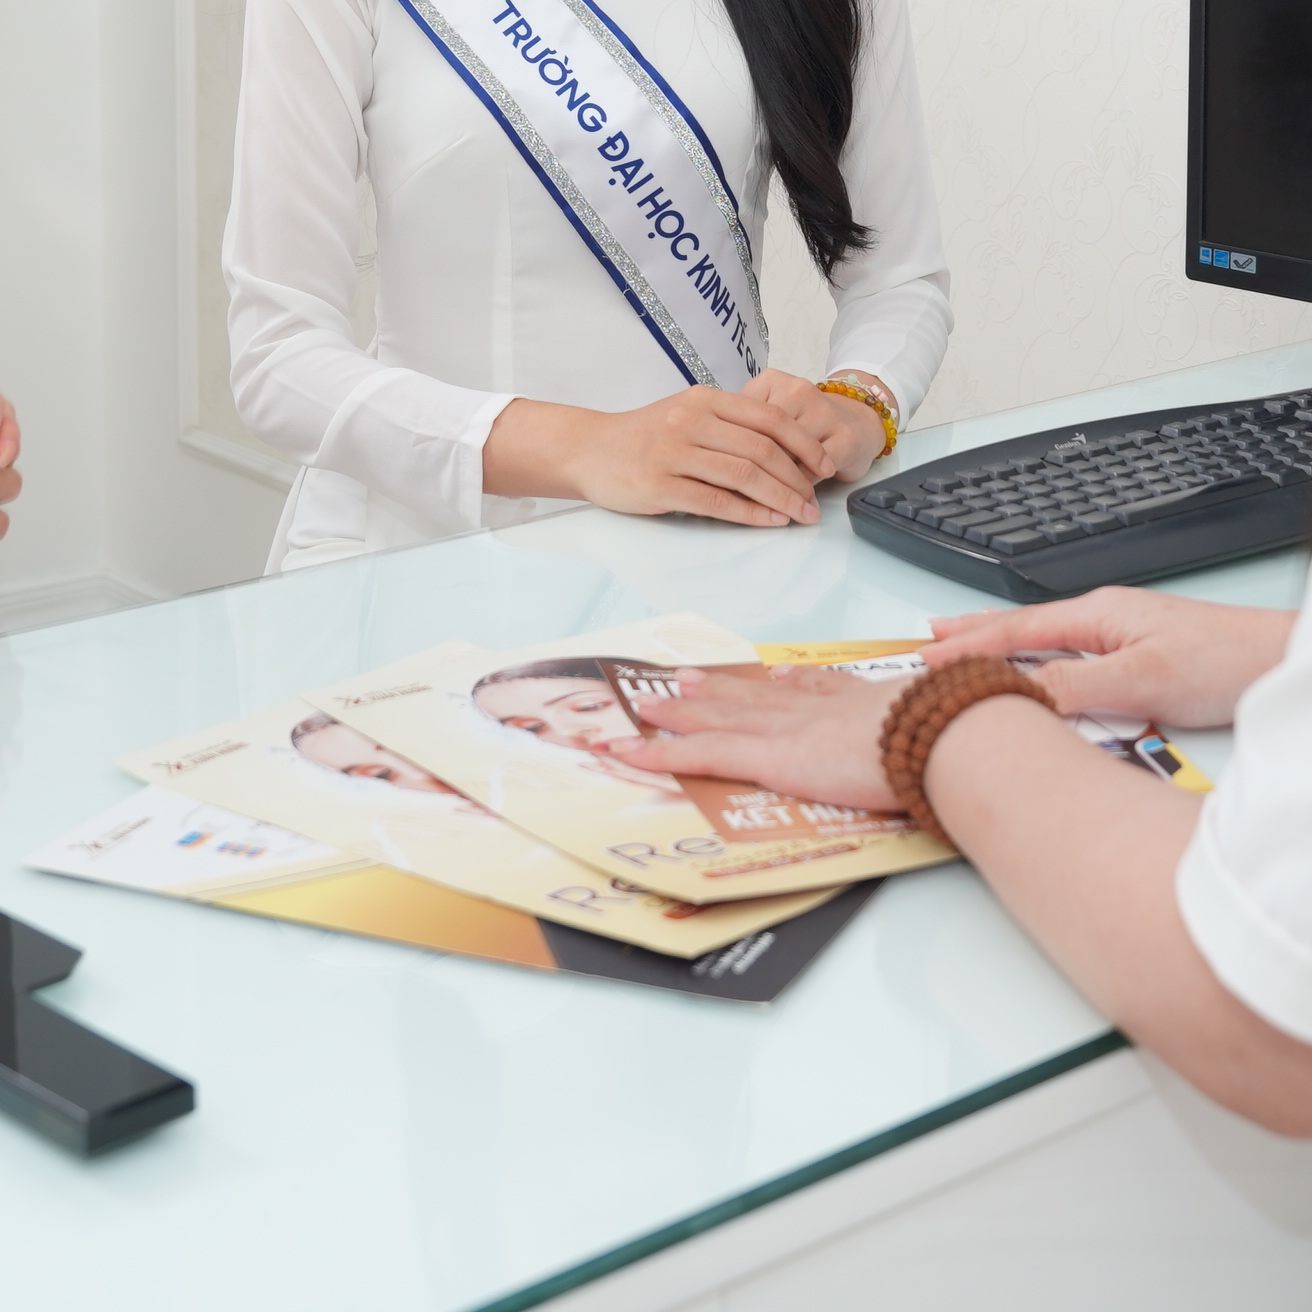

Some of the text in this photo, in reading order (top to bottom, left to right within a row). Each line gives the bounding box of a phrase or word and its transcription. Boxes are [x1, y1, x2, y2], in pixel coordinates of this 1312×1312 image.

[597, 130, 655, 195] ĐẠI
[636, 186, 700, 262] HỌC
[686, 253, 737, 328] KINH
